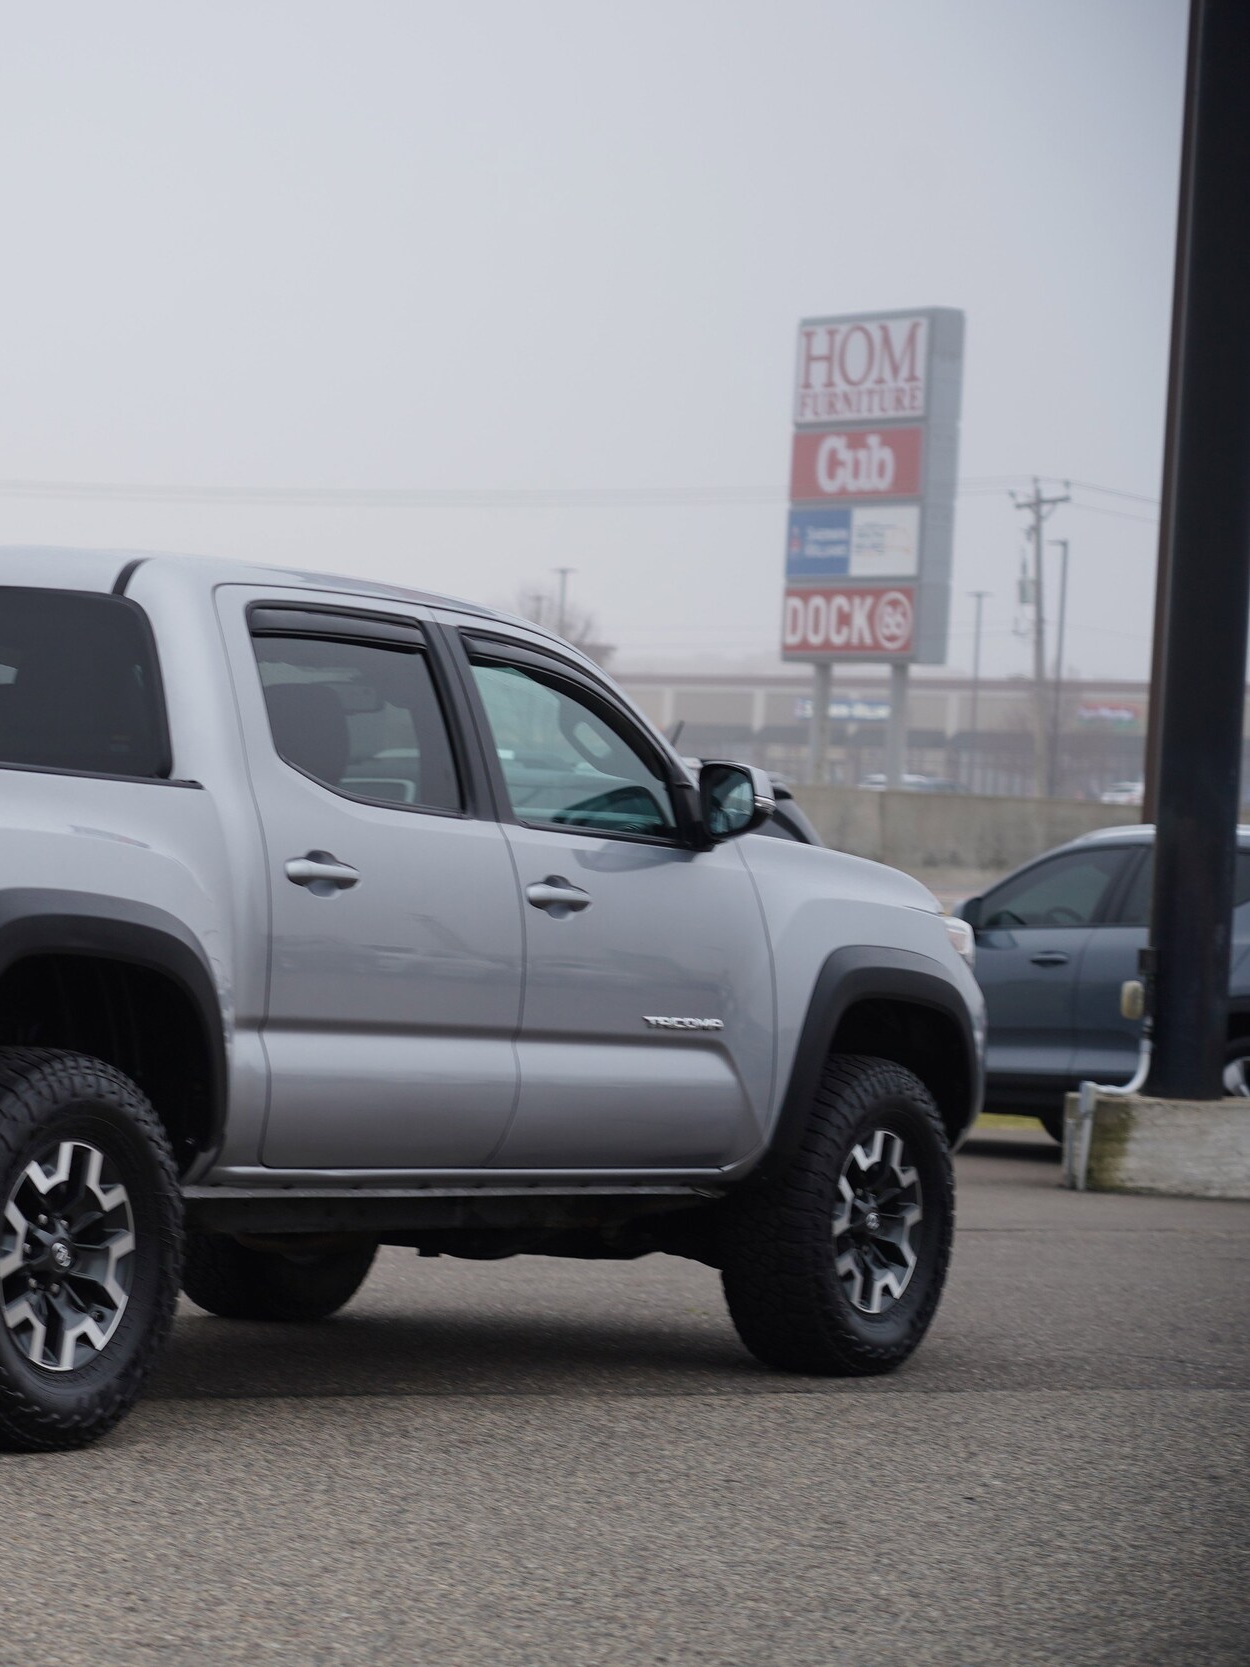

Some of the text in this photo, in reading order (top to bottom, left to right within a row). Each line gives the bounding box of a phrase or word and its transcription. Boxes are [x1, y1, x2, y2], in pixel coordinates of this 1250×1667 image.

[800, 320, 923, 390] HOM
[799, 385, 923, 417] FURNITURE
[816, 433, 896, 494] Cub
[784, 594, 876, 647] DOCK
